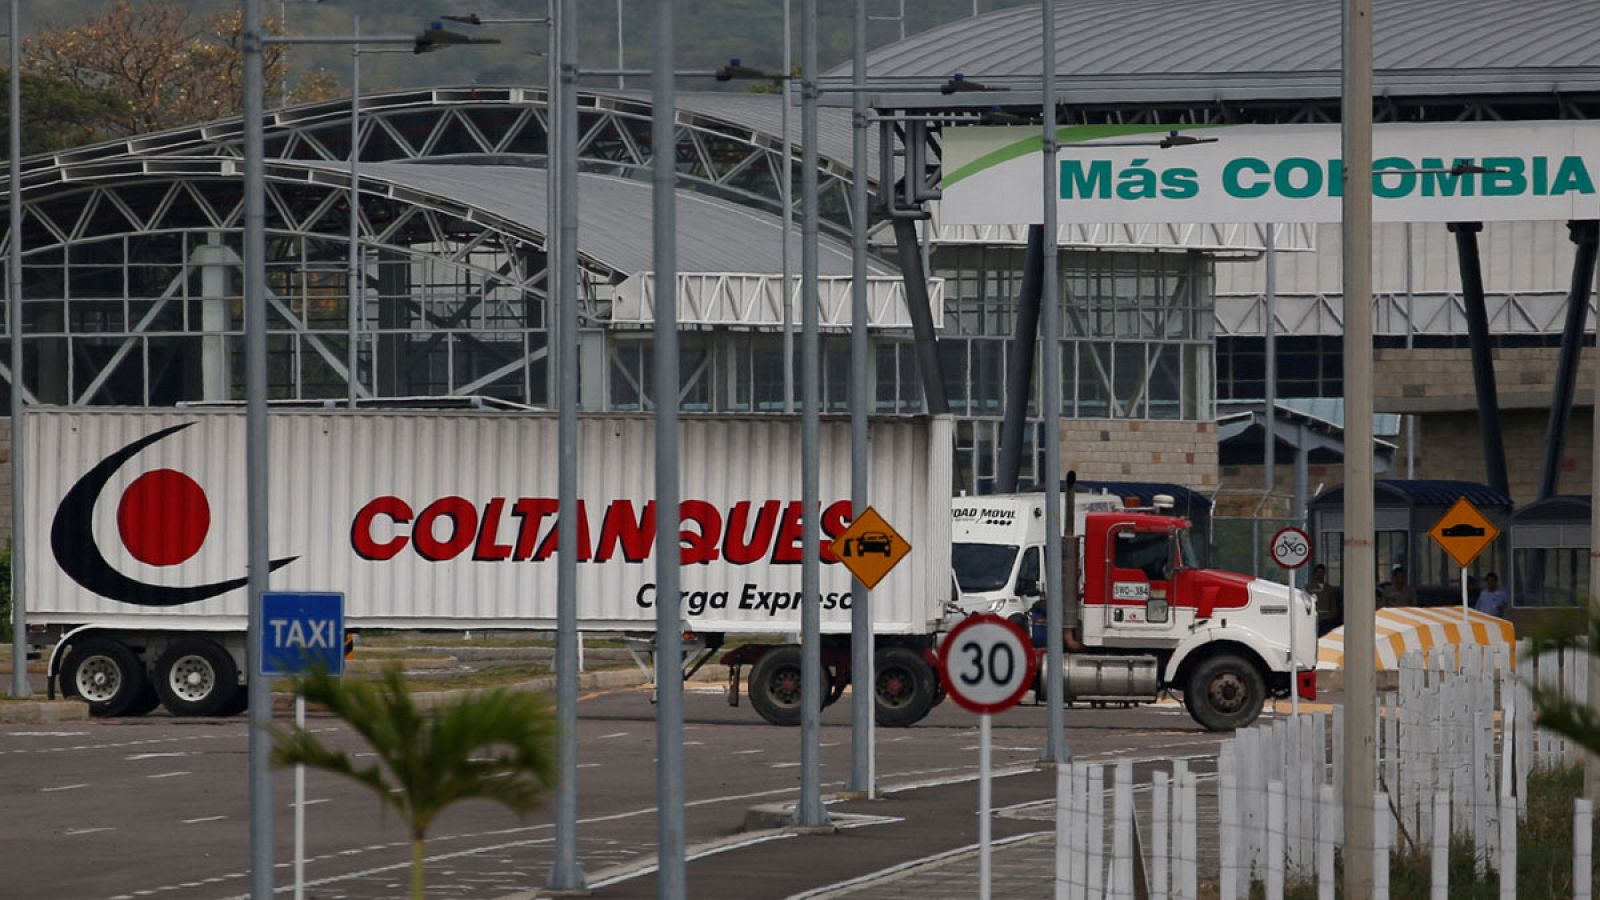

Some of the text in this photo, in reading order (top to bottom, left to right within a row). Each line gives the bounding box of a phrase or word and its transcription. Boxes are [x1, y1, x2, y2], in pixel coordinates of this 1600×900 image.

[1059, 158, 1199, 199] Más
[636, 583, 728, 617] Crga
[269, 619, 336, 648] TAXI
[960, 641, 1014, 686] 30
